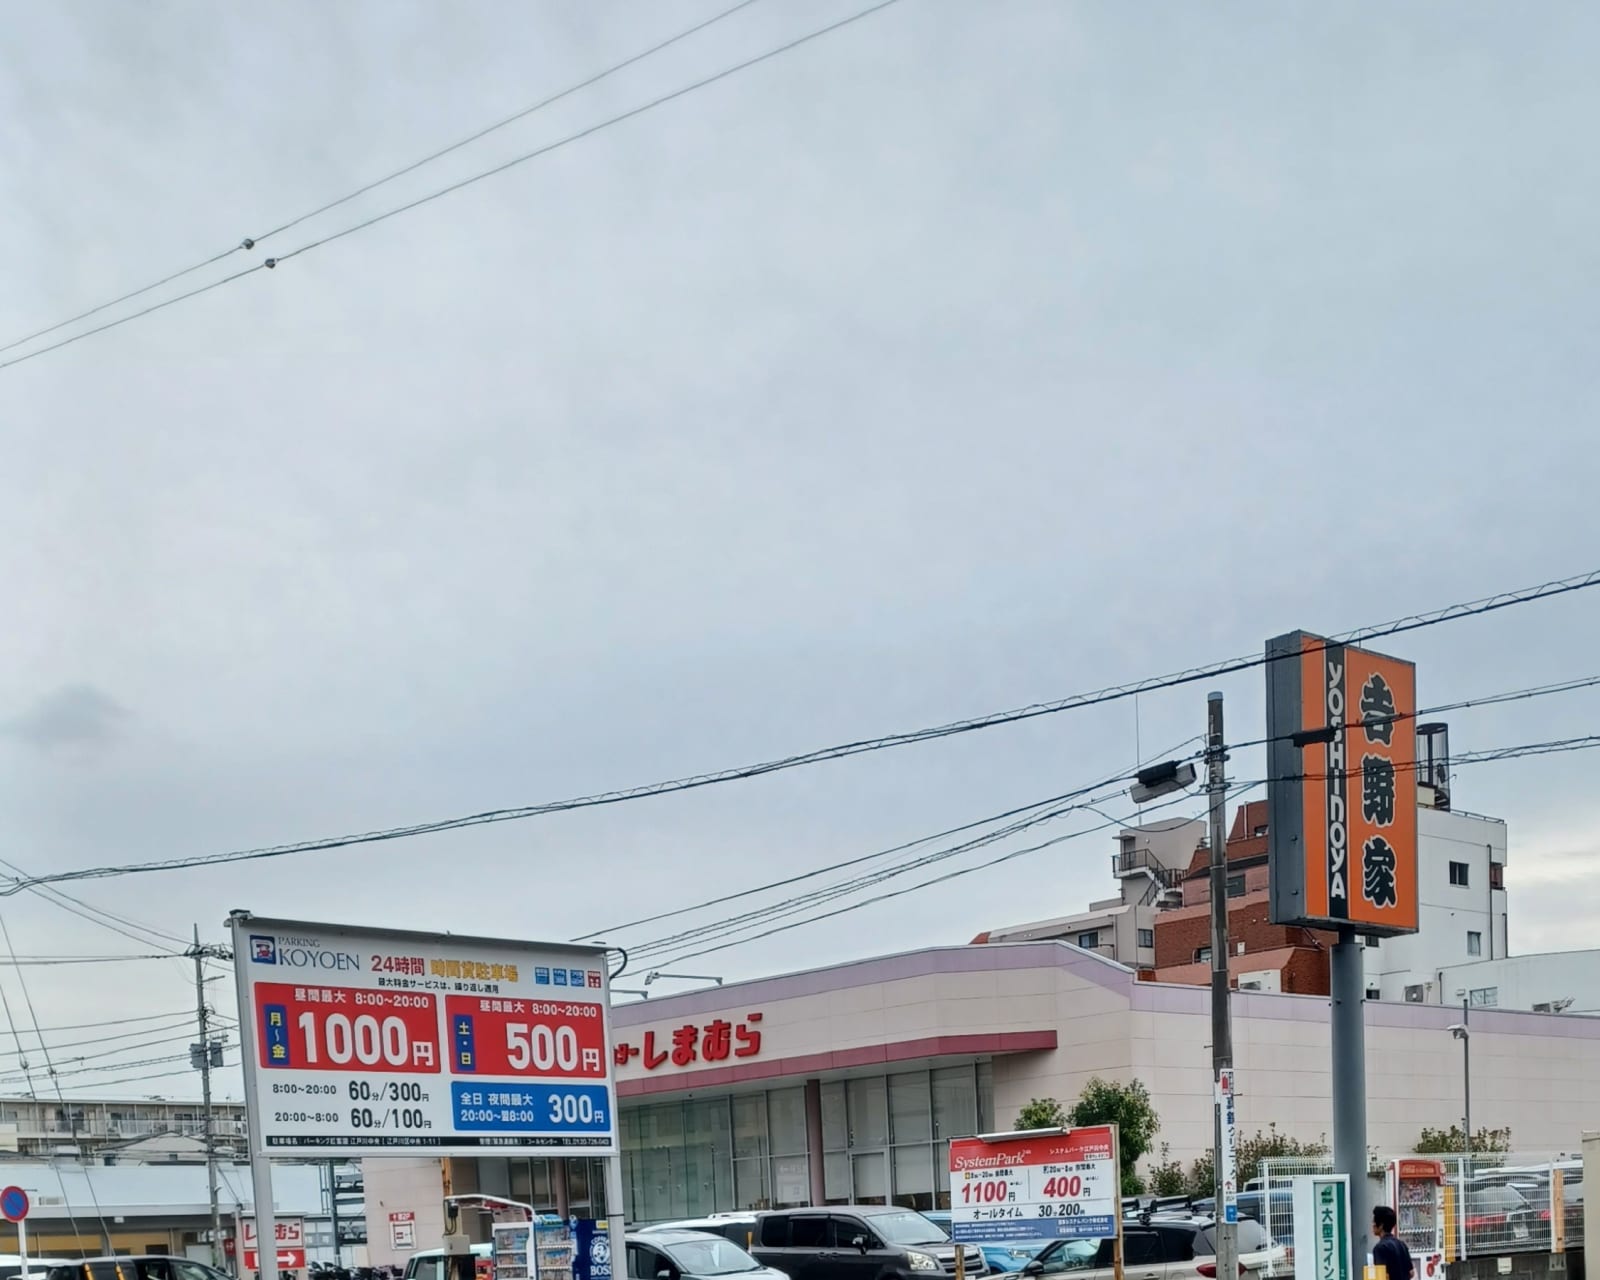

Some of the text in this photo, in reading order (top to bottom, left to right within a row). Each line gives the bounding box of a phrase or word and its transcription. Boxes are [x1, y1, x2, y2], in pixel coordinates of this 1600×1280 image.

[278, 936, 321, 948] PARKING
[279, 948, 361, 971] KOYOEN
[371, 954, 426, 976] 24時間
[294, 988, 429, 1009] 昼間最大 8:00~20:00
[272, 1083, 337, 1095] 8:00~20:00
[460, 1092, 534, 1107] 全日 夜間最大
[274, 1111, 339, 1123] 20:00~8:00
[955, 1152, 1025, 1171] SystemPark
[244, 1222, 300, 1241] しむら
